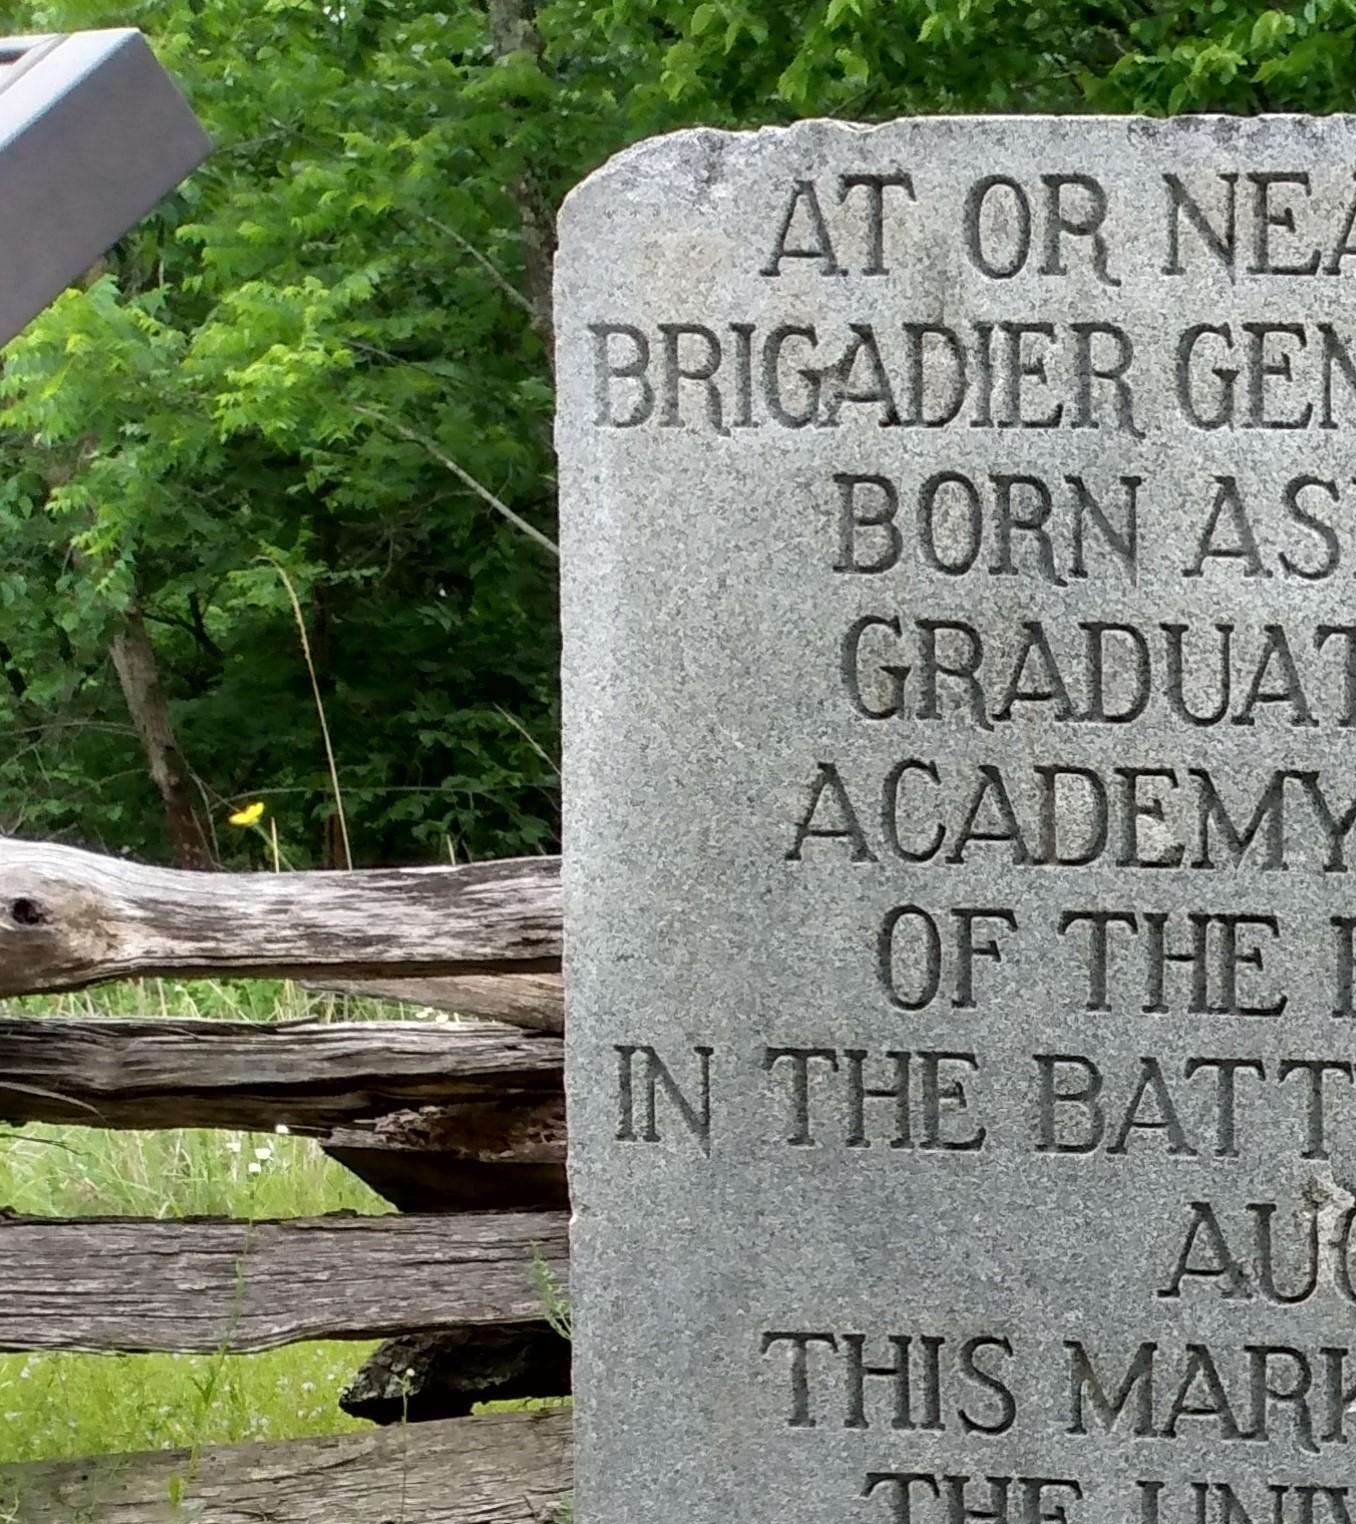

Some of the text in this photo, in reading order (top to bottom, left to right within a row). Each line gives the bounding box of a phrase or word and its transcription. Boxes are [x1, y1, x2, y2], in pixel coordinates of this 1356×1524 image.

[760, 173, 917, 277] AT
[963, 173, 1122, 287] OR
[588, 322, 1146, 438] BRIGADIER
[832, 471, 1142, 586] BORN
[877, 904, 1018, 1011] OF
[1057, 910, 1288, 1017] THE
[613, 1046, 714, 1158] IN
[763, 1047, 986, 1152] THE
[760, 1331, 1016, 1435] THIS
